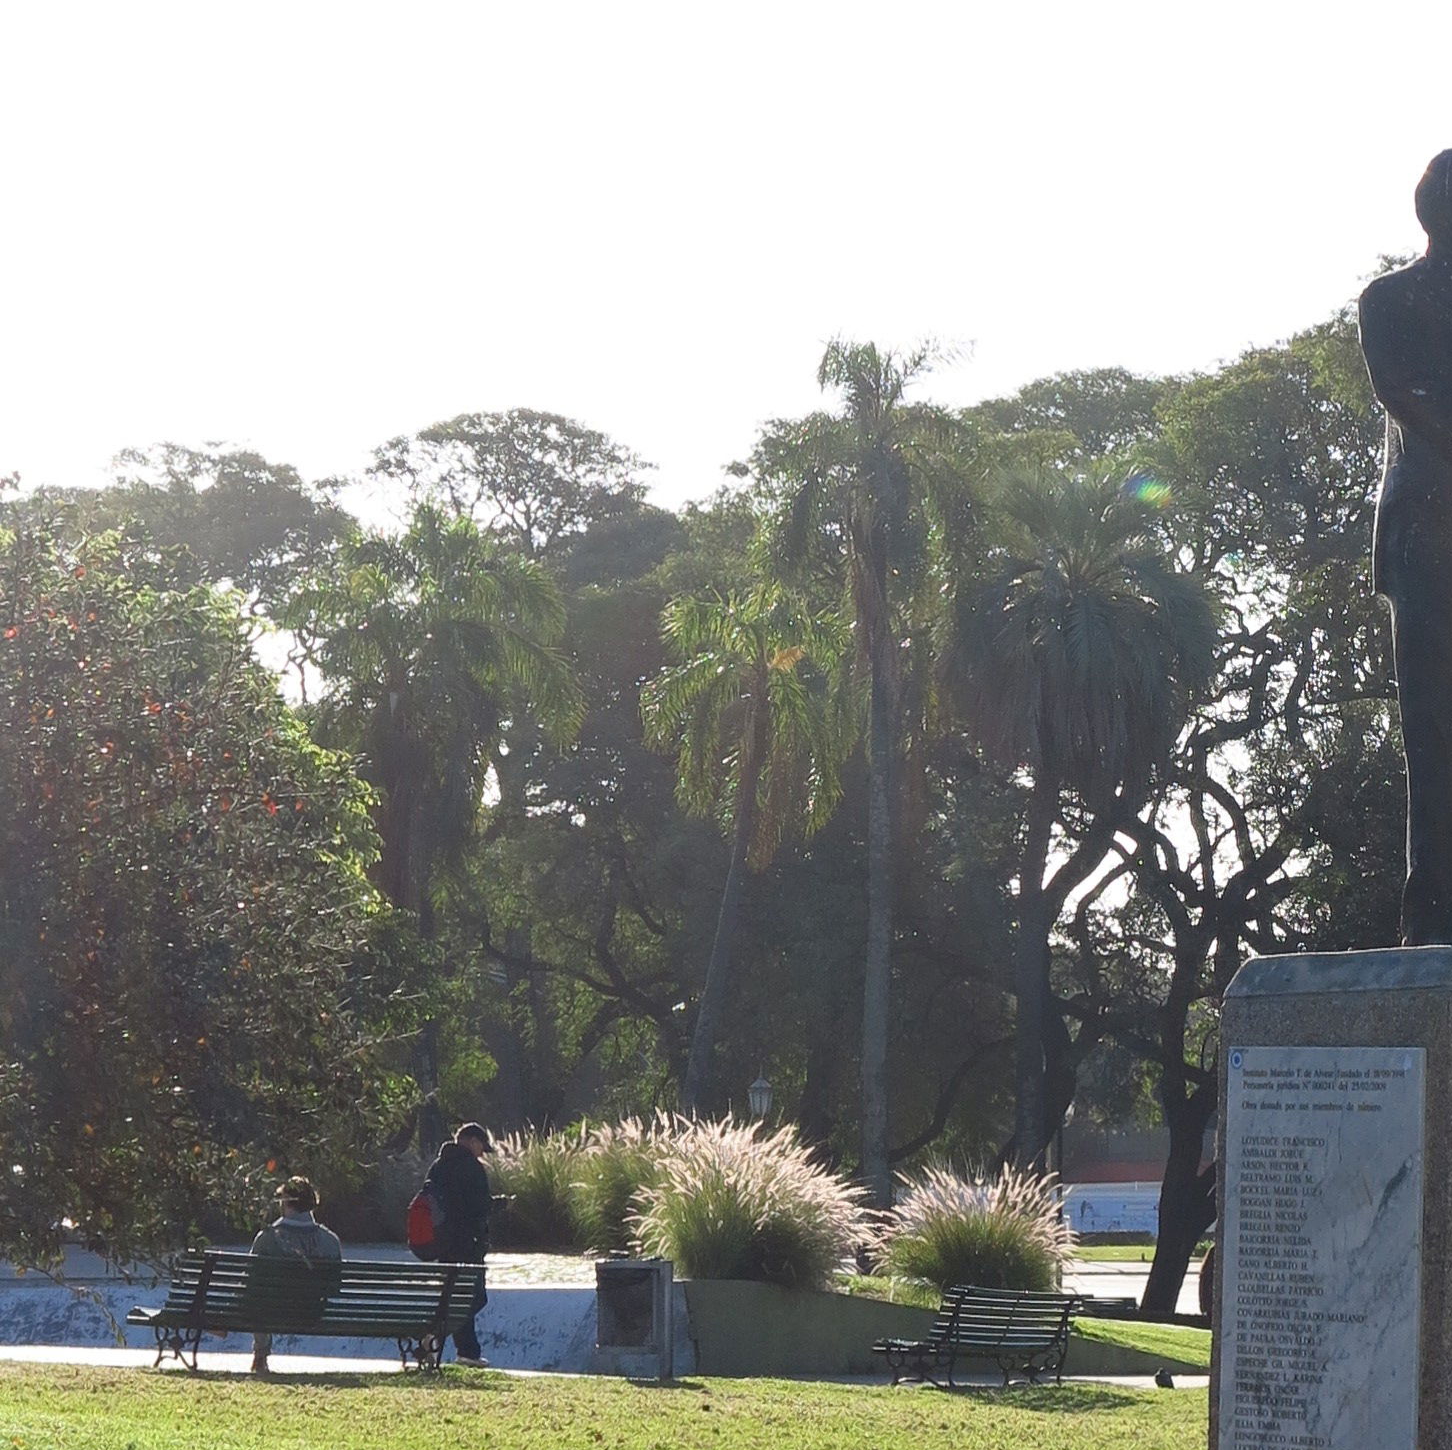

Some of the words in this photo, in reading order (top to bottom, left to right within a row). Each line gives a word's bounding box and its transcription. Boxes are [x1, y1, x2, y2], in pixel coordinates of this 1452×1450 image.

[1285, 1103, 1296, 1112] por
[1283, 1137, 1325, 1147] FRANCISCO
[1285, 1174, 1302, 1184] LUIS
[1263, 1260, 1297, 1270] ALBERTO
